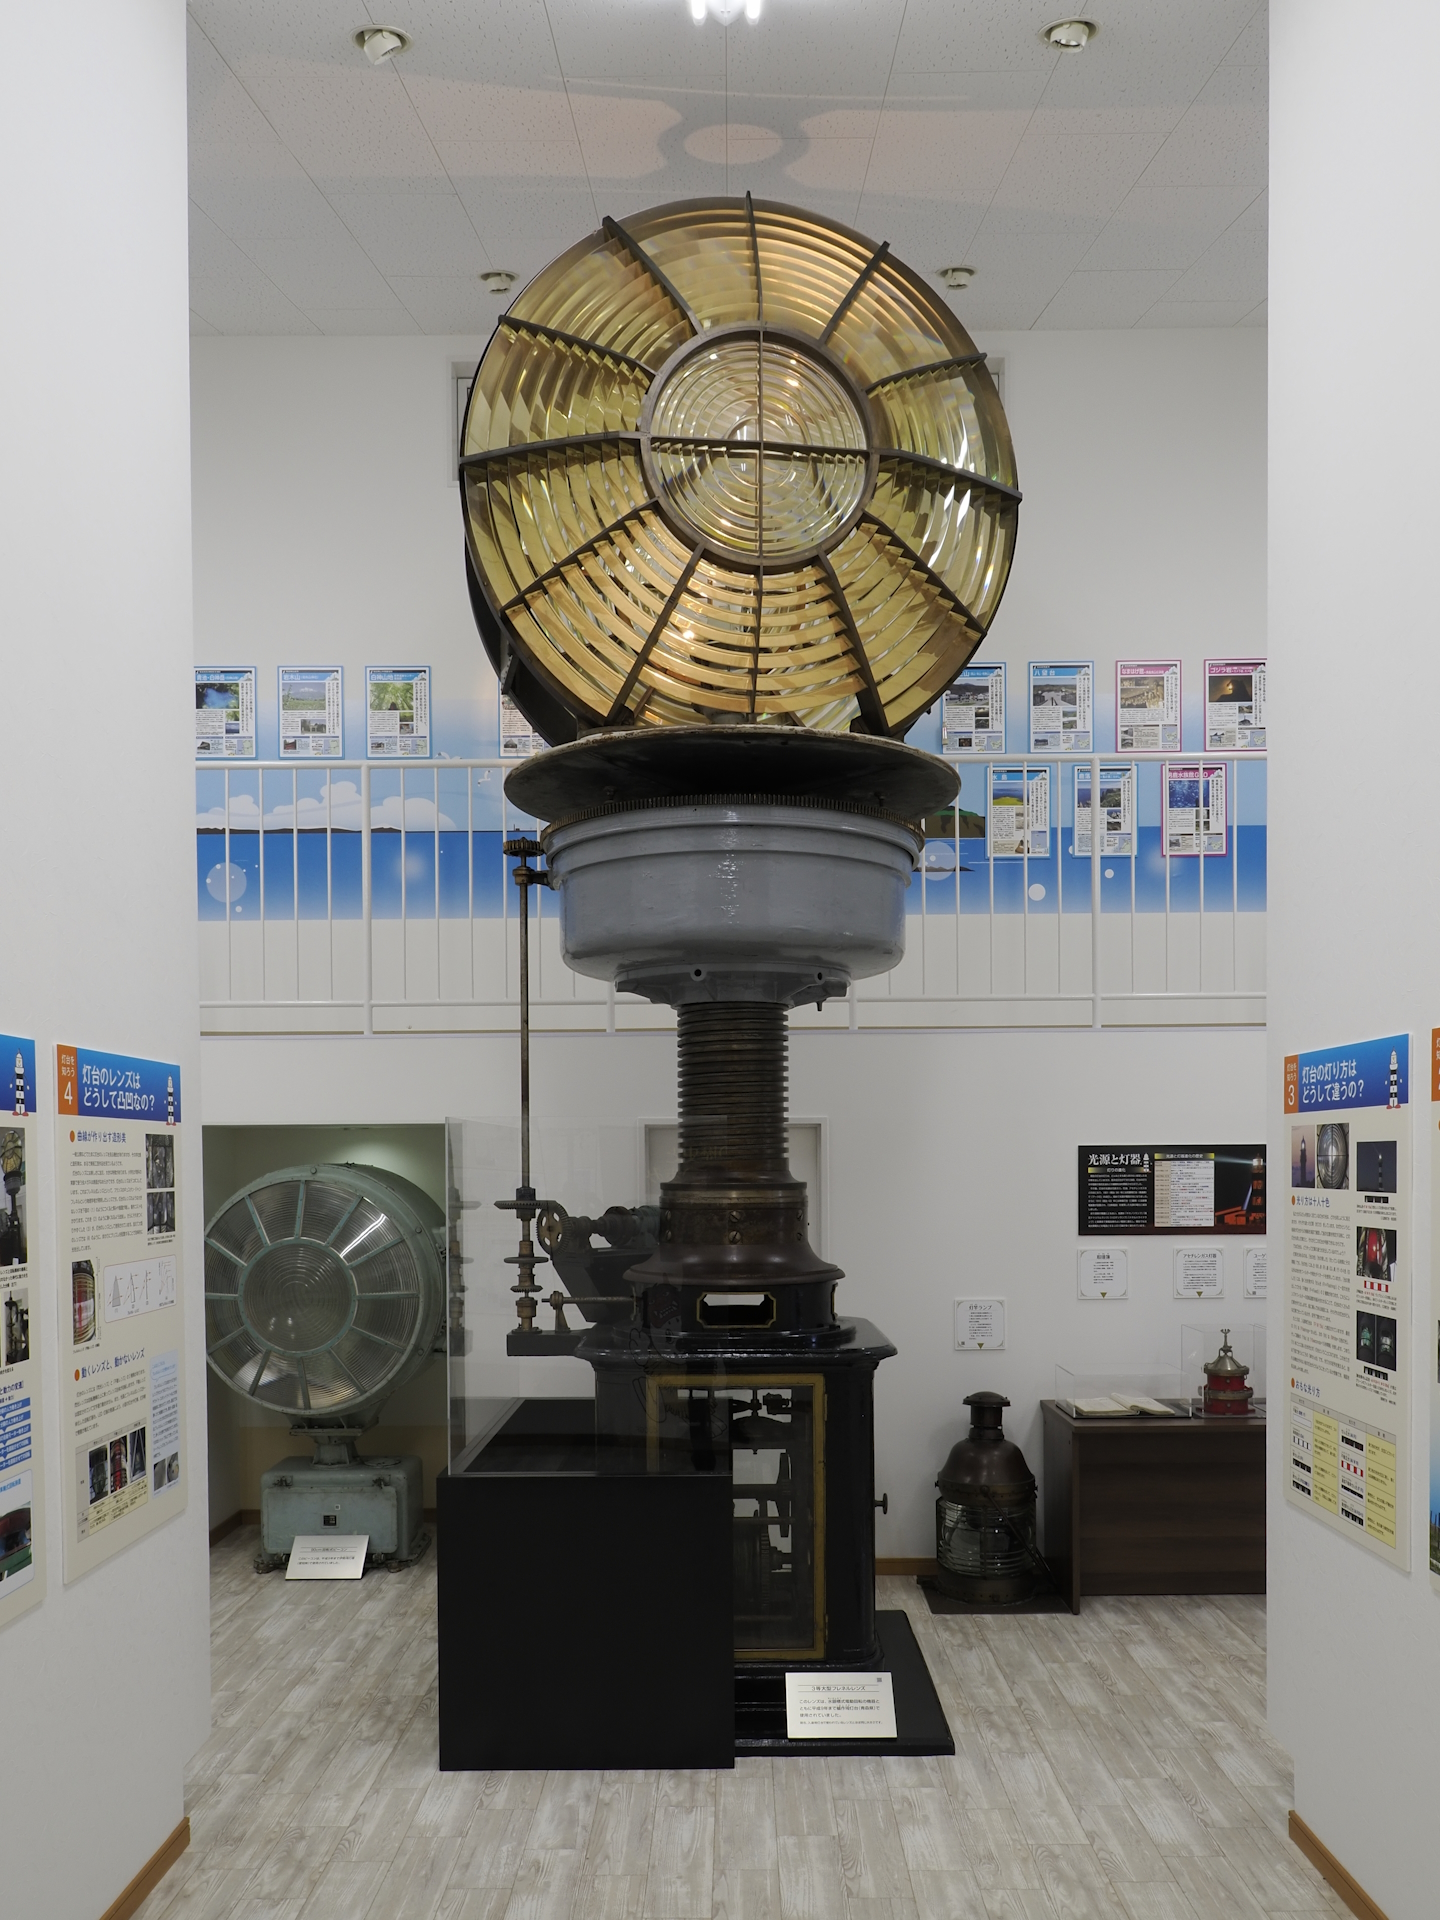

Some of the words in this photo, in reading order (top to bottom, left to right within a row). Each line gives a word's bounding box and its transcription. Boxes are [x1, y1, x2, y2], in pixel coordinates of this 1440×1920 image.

[62, 1054, 74, 1066] 灯台を
[1287, 1062, 1297, 1072] 灯台を
[62, 1066, 75, 1078] 知ろう
[82, 1064, 141, 1090] 灯台のレンズは
[1287, 1073, 1297, 1082] 知ろう
[1302, 1059, 1357, 1084] 灯台の灯り方は
[64, 1081, 73, 1105] 4
[83, 1087, 155, 1111] どうして凸凹なの？
[1288, 1084, 1295, 1106] 3
[1302, 1080, 1364, 1103] どうして違うの？
[77, 1130, 126, 1143] 曲線が作り出す造形美
[1088, 1154, 1141, 1166] 光源と灯器
[1296, 1196, 1330, 1208] 光り方は十人十色
[81, 1348, 145, 1378] 動くレンズと、動かないレンズ
[1295, 1380, 1320, 1398] おもな光り方
